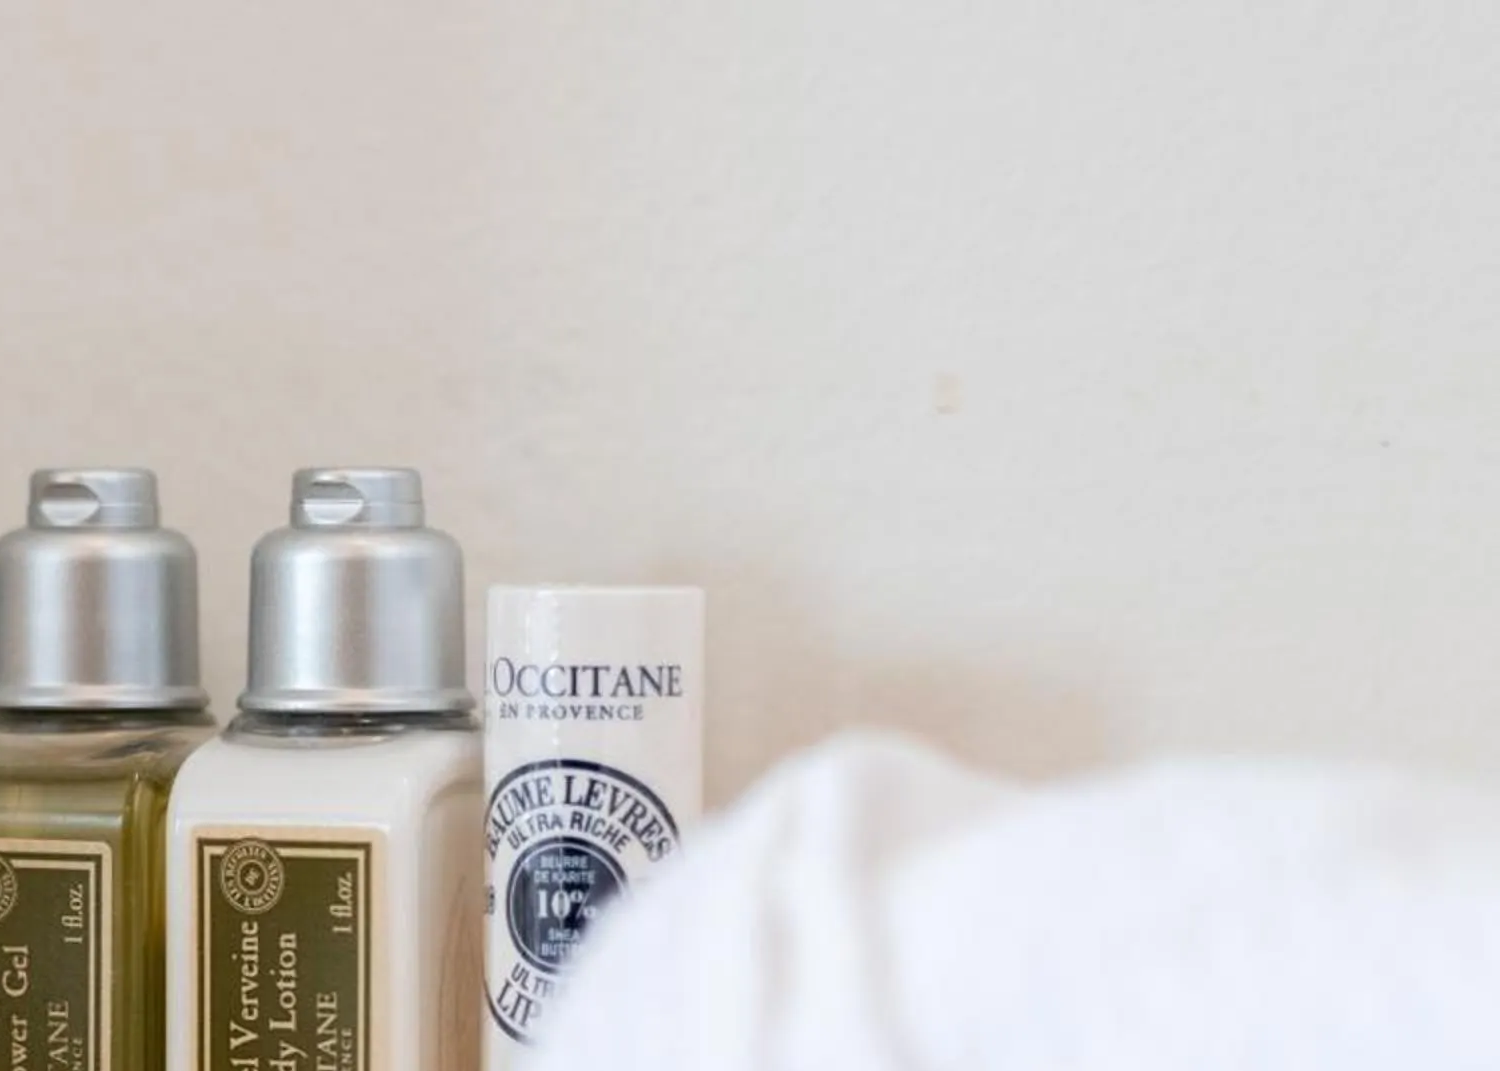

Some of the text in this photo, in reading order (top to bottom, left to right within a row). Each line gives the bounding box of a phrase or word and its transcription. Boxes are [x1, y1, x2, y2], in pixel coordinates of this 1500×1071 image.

[500, 702, 643, 721] EN PROVENCE
[486, 776, 554, 860] BAUME
[507, 810, 630, 853] ULTRA RICHE
[534, 870, 549, 883] DE
[538, 889, 597, 919] 10%
[333, 926, 352, 934] 1
[548, 928, 580, 941] SHEA
[3, 945, 29, 997] Gel
[231, 922, 257, 1049] Verveine
[269, 934, 296, 1031] Lotion
